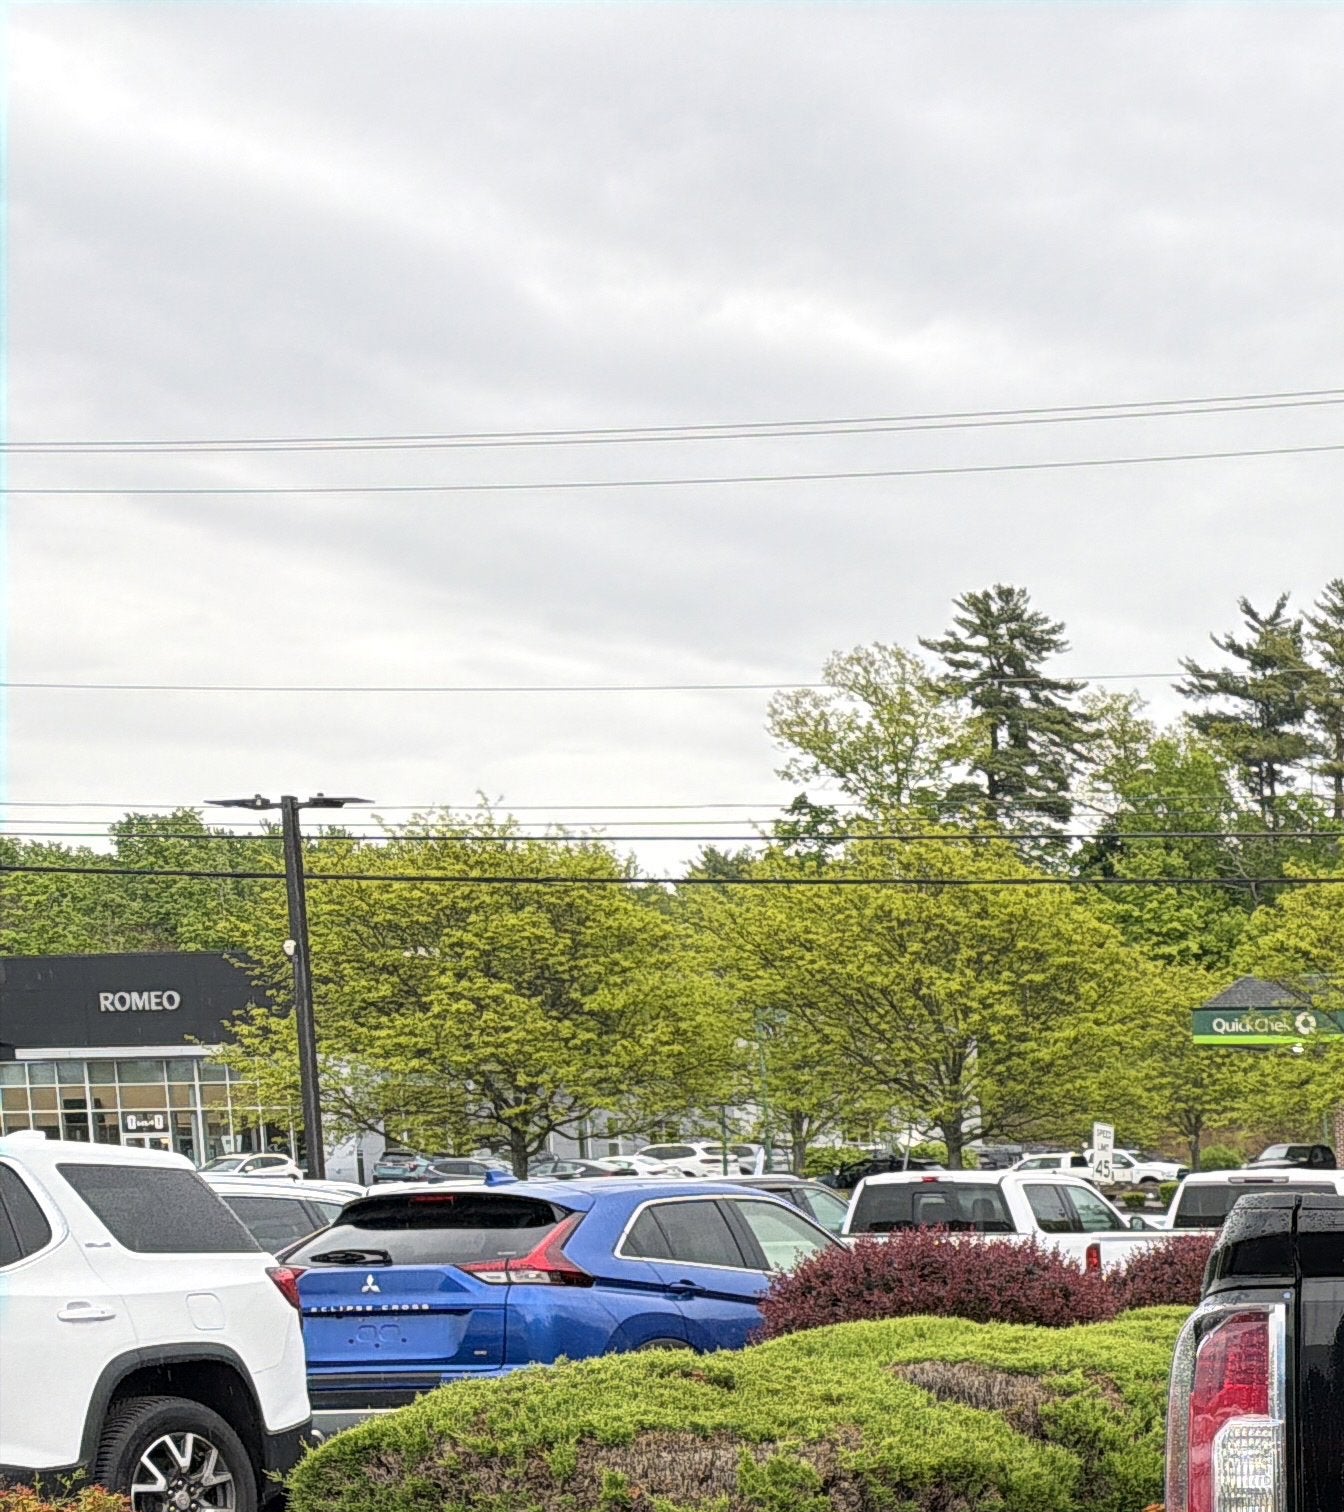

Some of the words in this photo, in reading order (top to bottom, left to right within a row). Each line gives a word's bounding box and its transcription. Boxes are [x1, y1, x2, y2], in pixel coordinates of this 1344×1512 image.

[99, 990, 181, 1012] ROMEO
[1095, 1159, 1111, 1178] 45
[381, 1303, 430, 1311] CROSS
